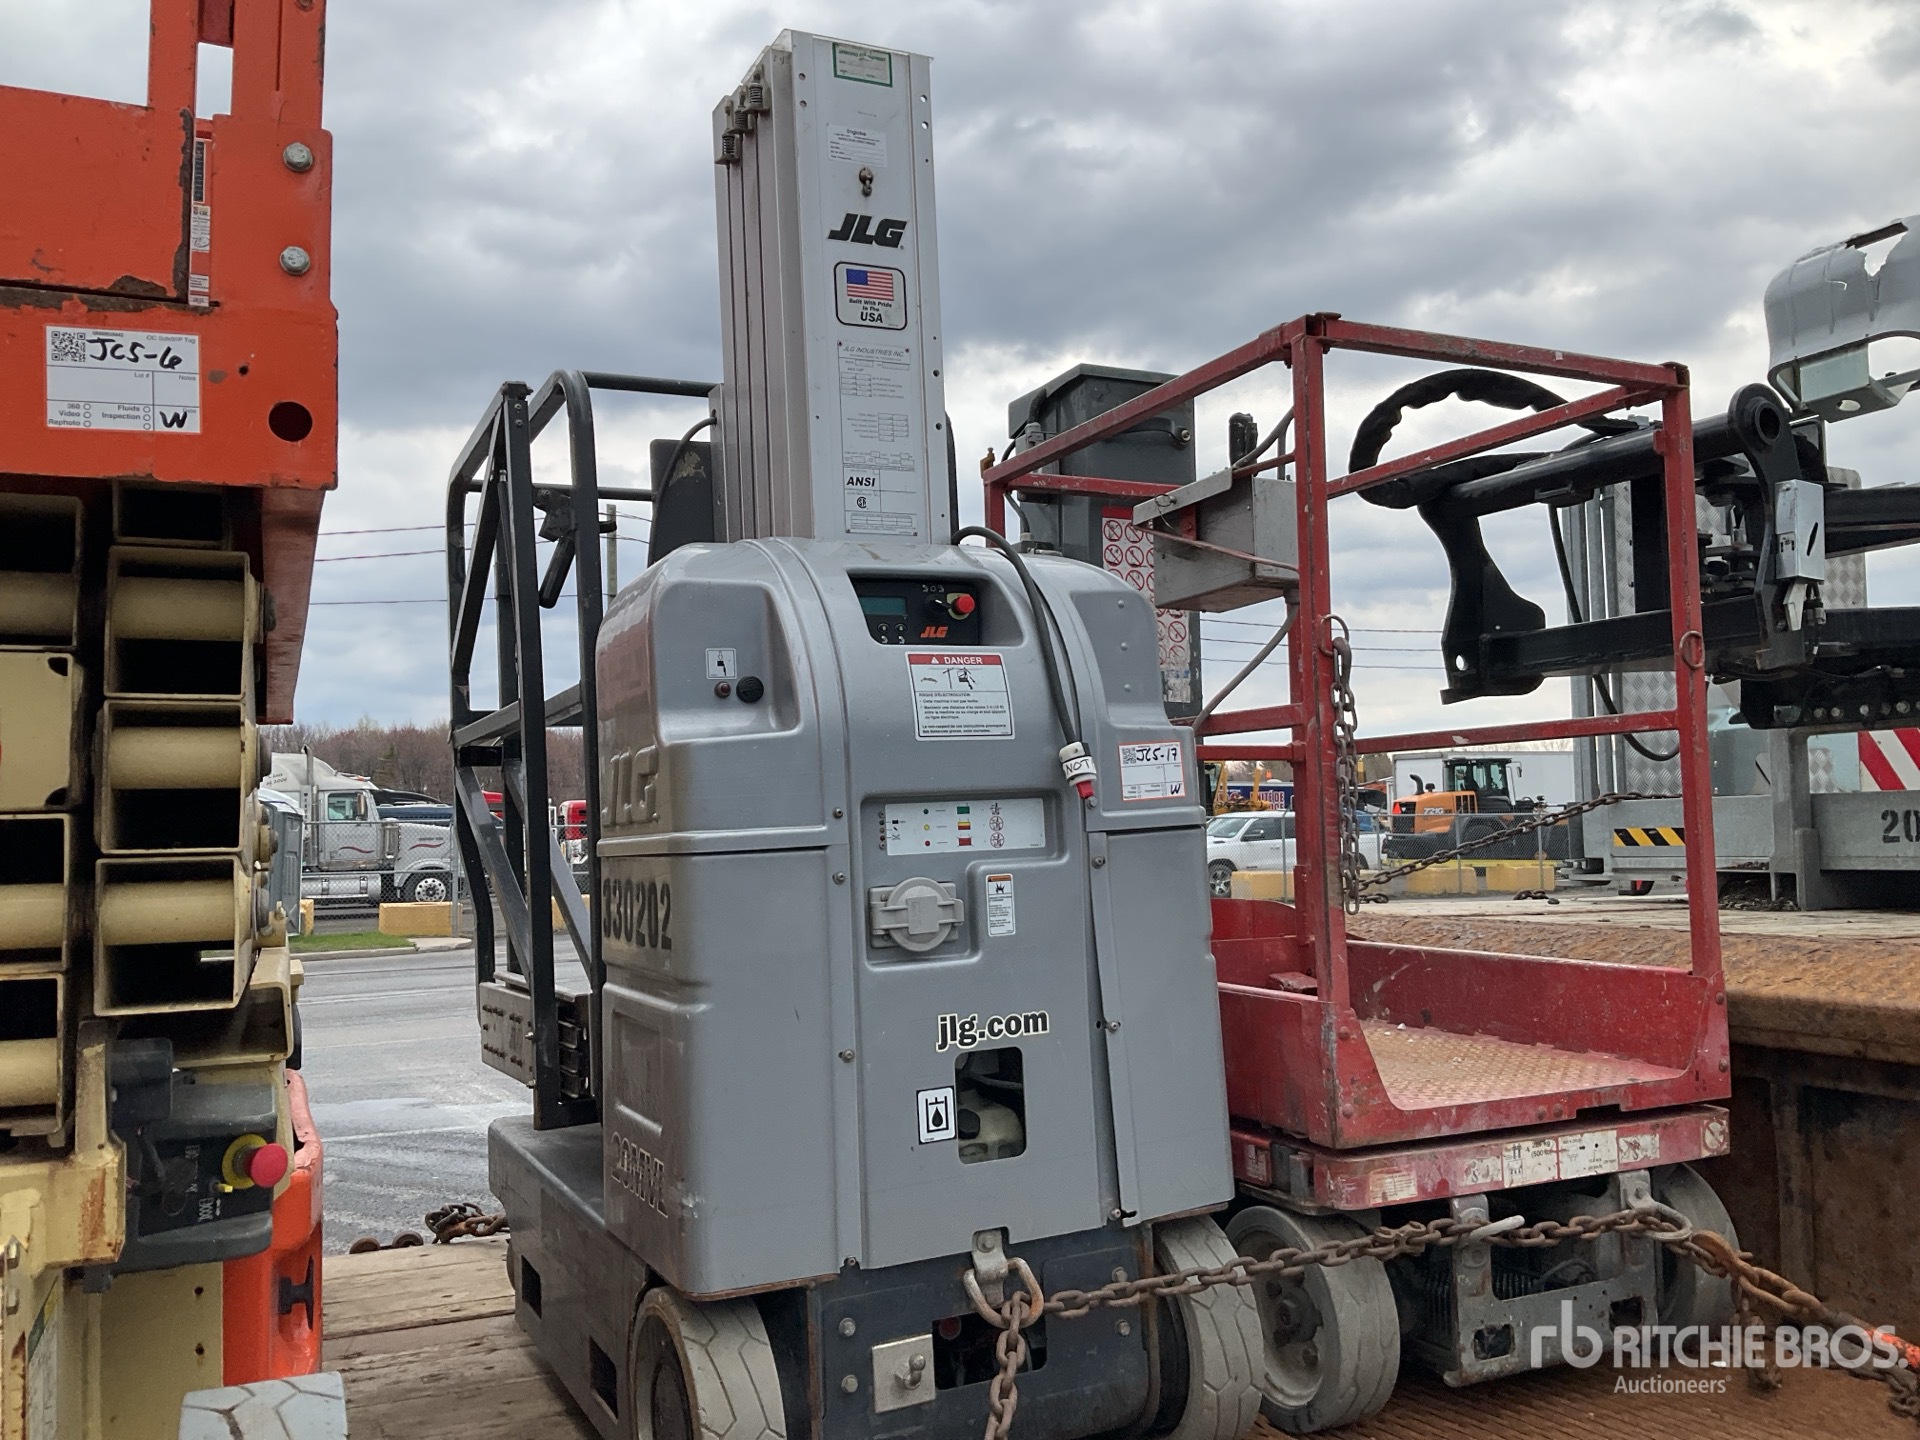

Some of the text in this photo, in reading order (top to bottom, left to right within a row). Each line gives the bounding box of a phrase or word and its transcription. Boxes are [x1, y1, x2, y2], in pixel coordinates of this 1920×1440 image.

[828, 213, 907, 248] JLG
[860, 312, 883, 323] USA
[855, 347, 892, 355] INDUSTRIES
[102, 412, 140, 420] Inspection
[160, 411, 188, 429] W
[48, 419, 81, 427] Rephoto
[846, 476, 876, 487] ANSI
[920, 626, 949, 638] JLG
[944, 656, 983, 665] DANGER
[1065, 759, 1090, 773] NOT
[1170, 784, 1181, 795] W
[1274, 791, 1285, 801] DE
[603, 877, 672, 950] 330202
[937, 1011, 1048, 1051] jlg.com
